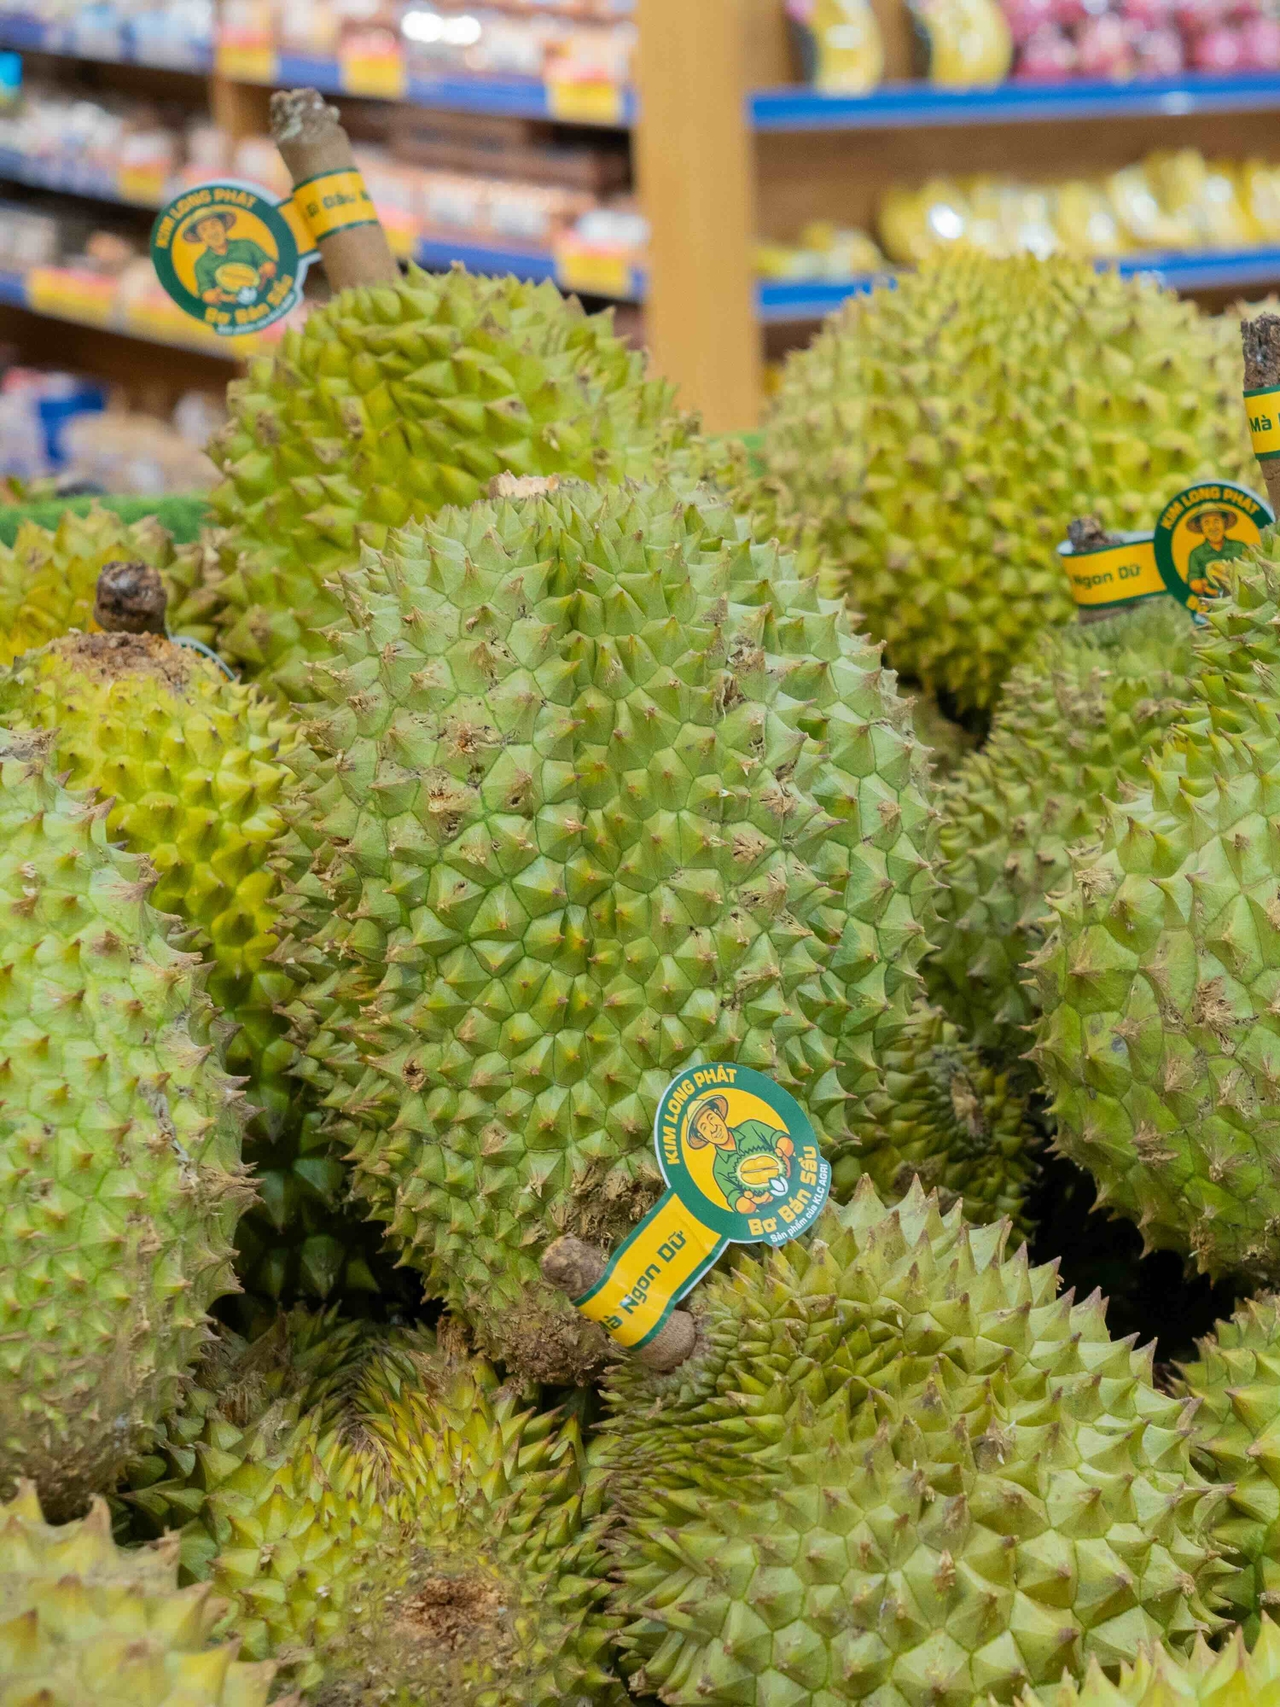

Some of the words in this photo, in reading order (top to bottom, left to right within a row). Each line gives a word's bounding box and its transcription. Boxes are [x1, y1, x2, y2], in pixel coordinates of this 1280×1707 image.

[169, 189, 211, 219] LONG
[1249, 414, 1273, 433] Mà
[1161, 501, 1184, 530] KIM
[1181, 485, 1221, 508] LONG
[692, 1064, 738, 1089] PHÁT
[664, 1079, 696, 1125] LONG
[662, 1125, 681, 1165] KIM
[817, 1162, 829, 1187] AGRI
[777, 1188, 813, 1224] Bán
[812, 1186, 826, 1206] KLC
[619, 1263, 662, 1316] Ngon
[656, 1230, 687, 1264] Dữ
